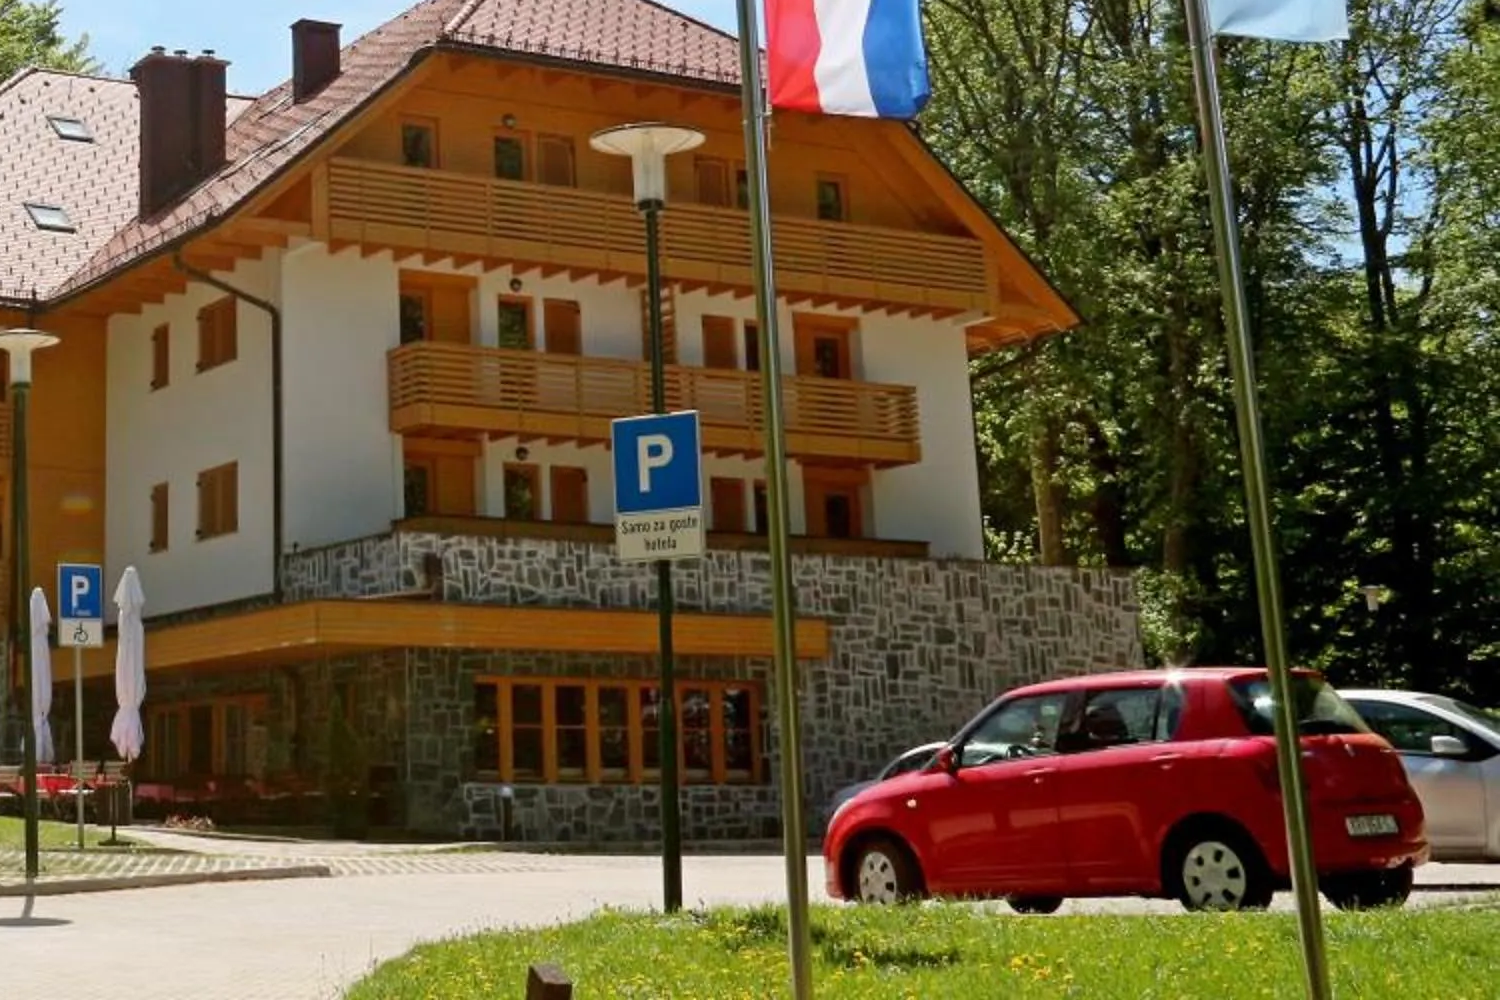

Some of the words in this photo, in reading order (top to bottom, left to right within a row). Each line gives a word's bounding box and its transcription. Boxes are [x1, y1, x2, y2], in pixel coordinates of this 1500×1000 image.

[637, 434, 673, 493] P
[621, 519, 650, 534] Samo
[653, 519, 665, 532] za
[71, 575, 90, 608] P
